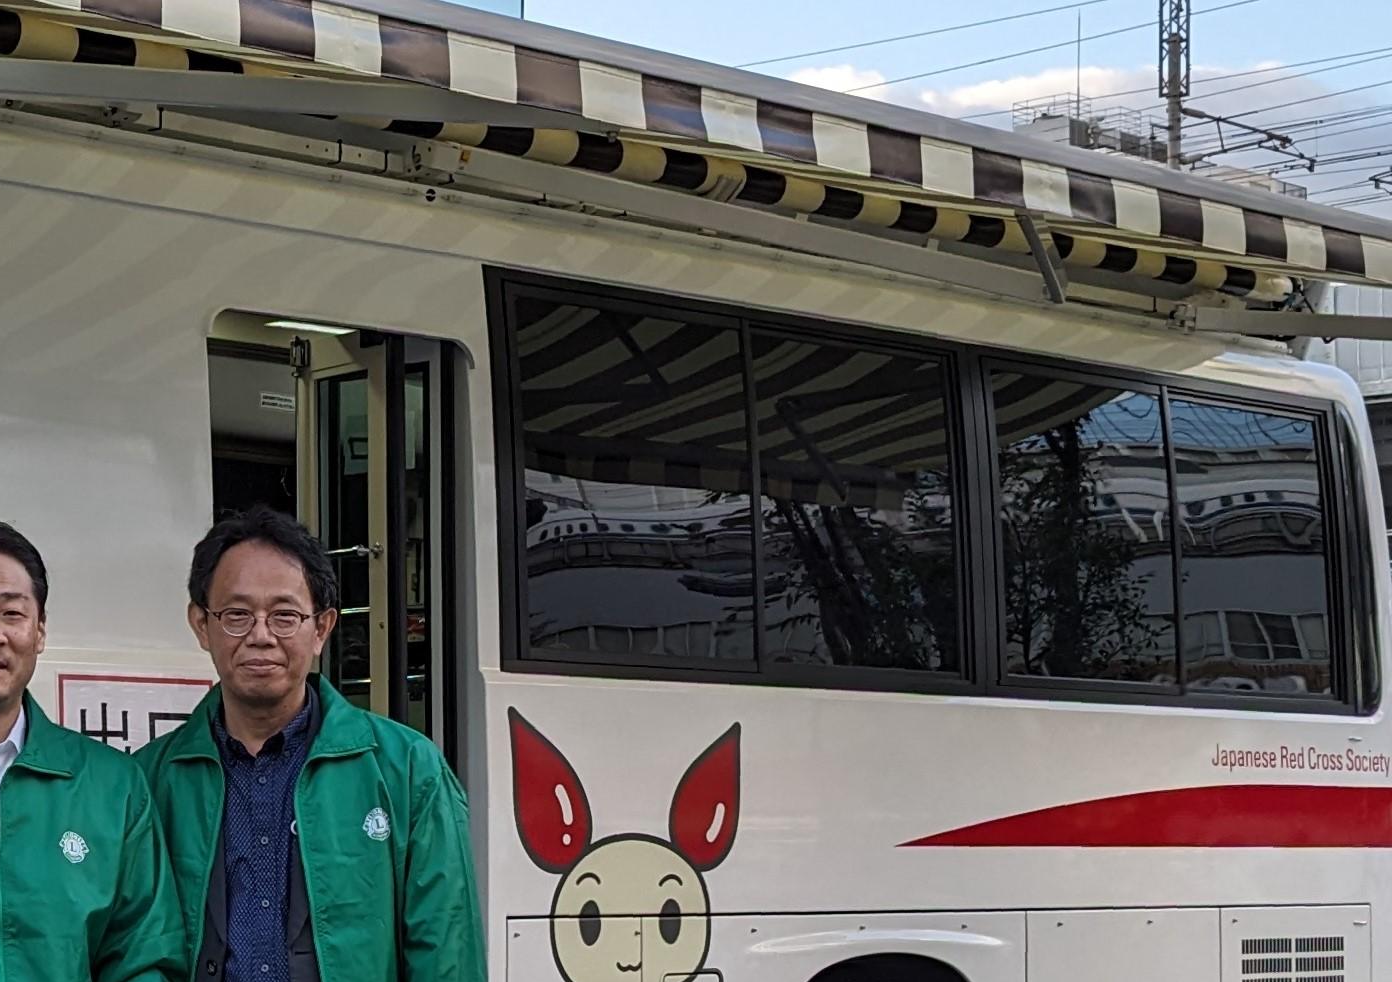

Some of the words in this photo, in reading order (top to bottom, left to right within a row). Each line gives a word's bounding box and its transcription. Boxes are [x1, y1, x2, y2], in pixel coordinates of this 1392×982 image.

[1212, 743, 1277, 771] Japanese
[1281, 746, 1305, 770] Red
[1307, 747, 1343, 771] Cross
[1346, 748, 1391, 777] Society
